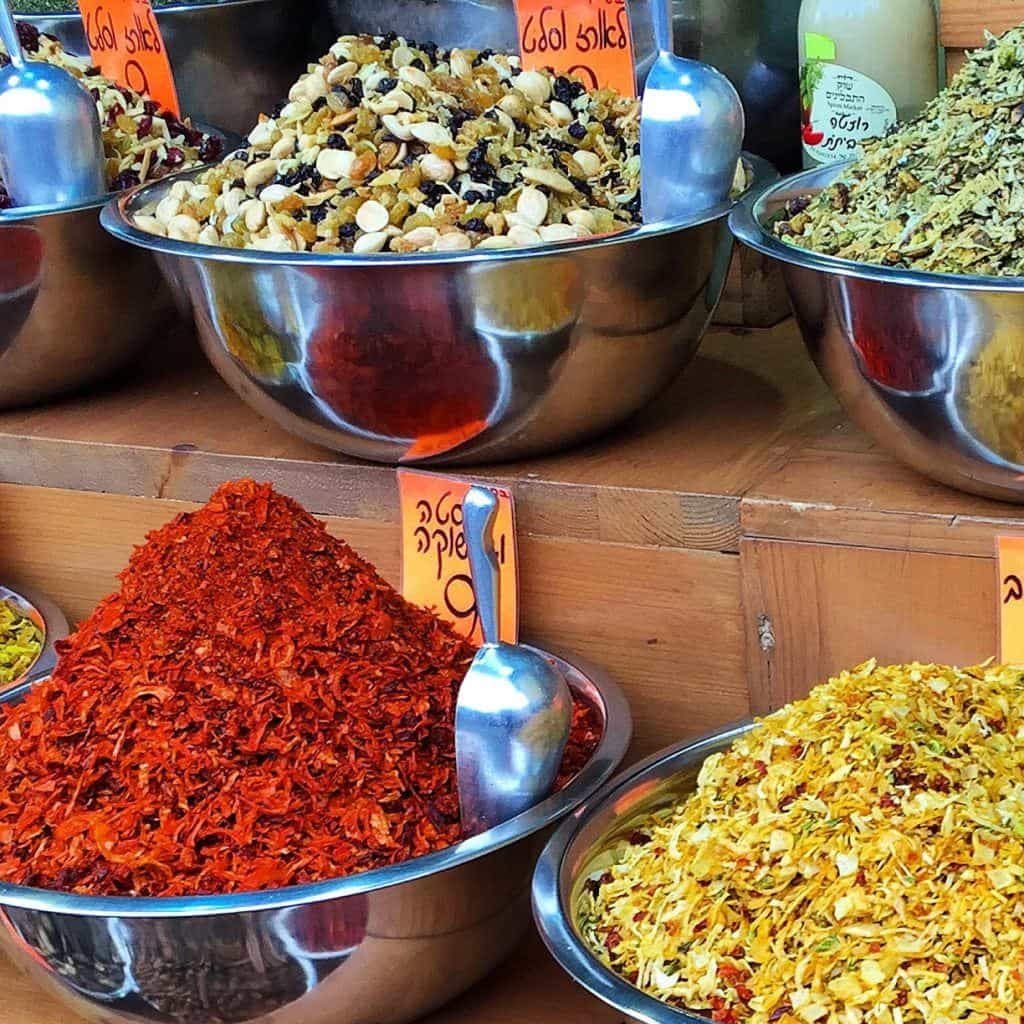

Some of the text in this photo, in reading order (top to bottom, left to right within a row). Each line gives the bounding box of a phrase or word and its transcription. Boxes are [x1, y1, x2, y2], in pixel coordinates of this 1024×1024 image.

[86, 6, 118, 51] וסלט
[522, 6, 627, 53] לאורז וסלט
[125, 59, 150, 96] 9
[416, 491, 465, 526] סטה
[444, 573, 478, 640] 9
